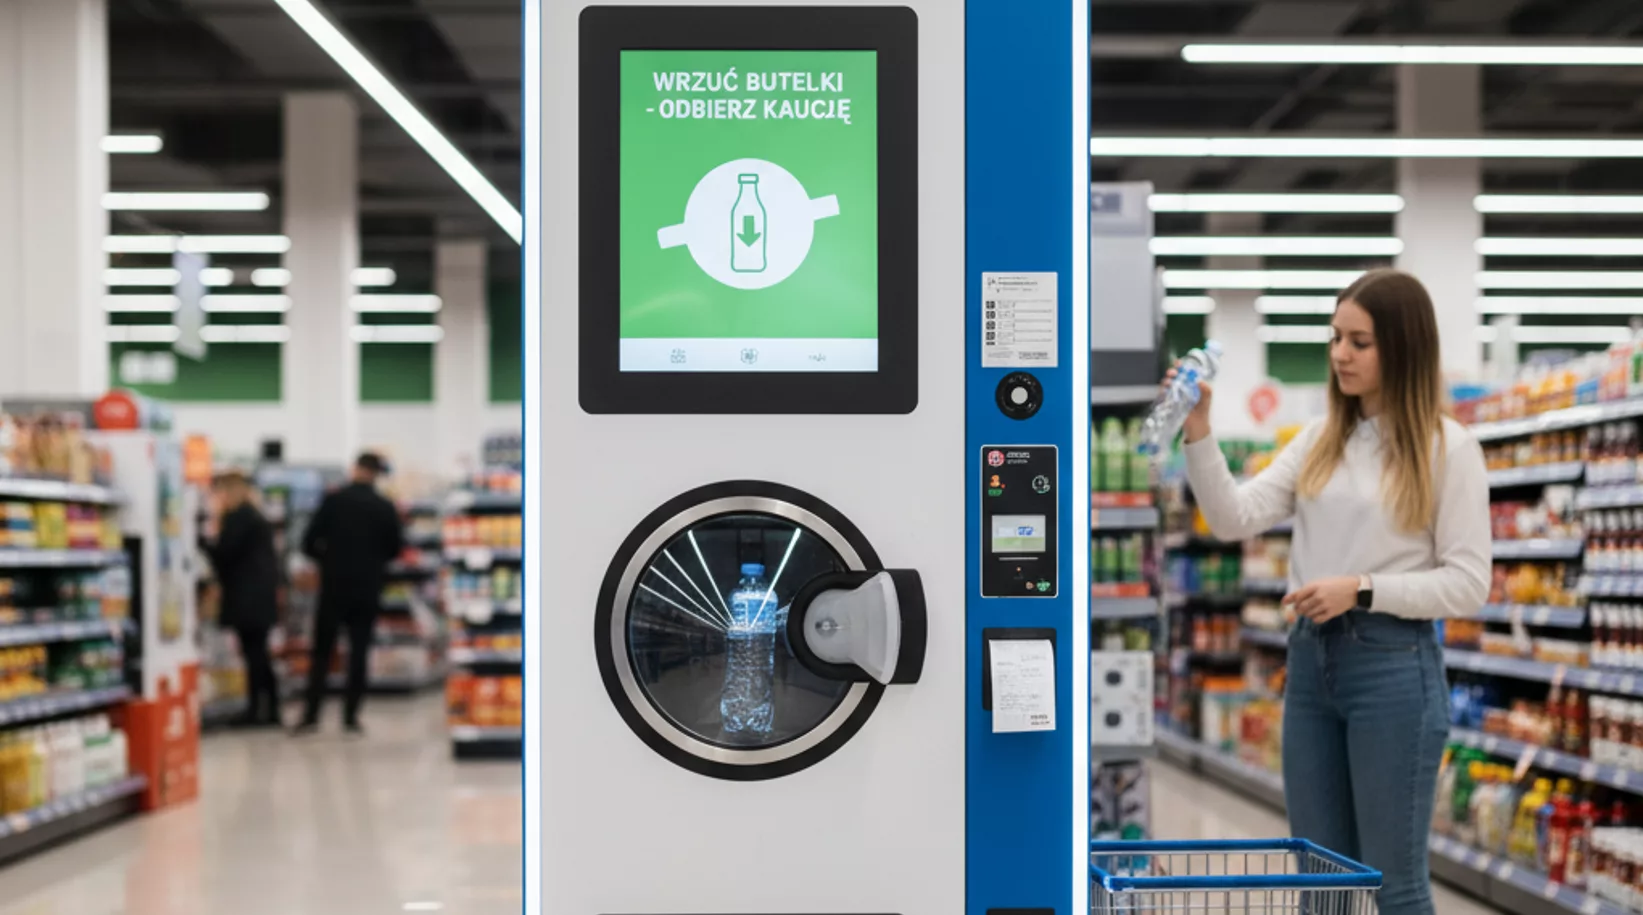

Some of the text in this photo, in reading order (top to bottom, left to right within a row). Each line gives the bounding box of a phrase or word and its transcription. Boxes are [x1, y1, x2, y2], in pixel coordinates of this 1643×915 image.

[653, 67, 844, 92] WRZUĆ BUTELKI
[659, 98, 757, 119] ODBIERZ
